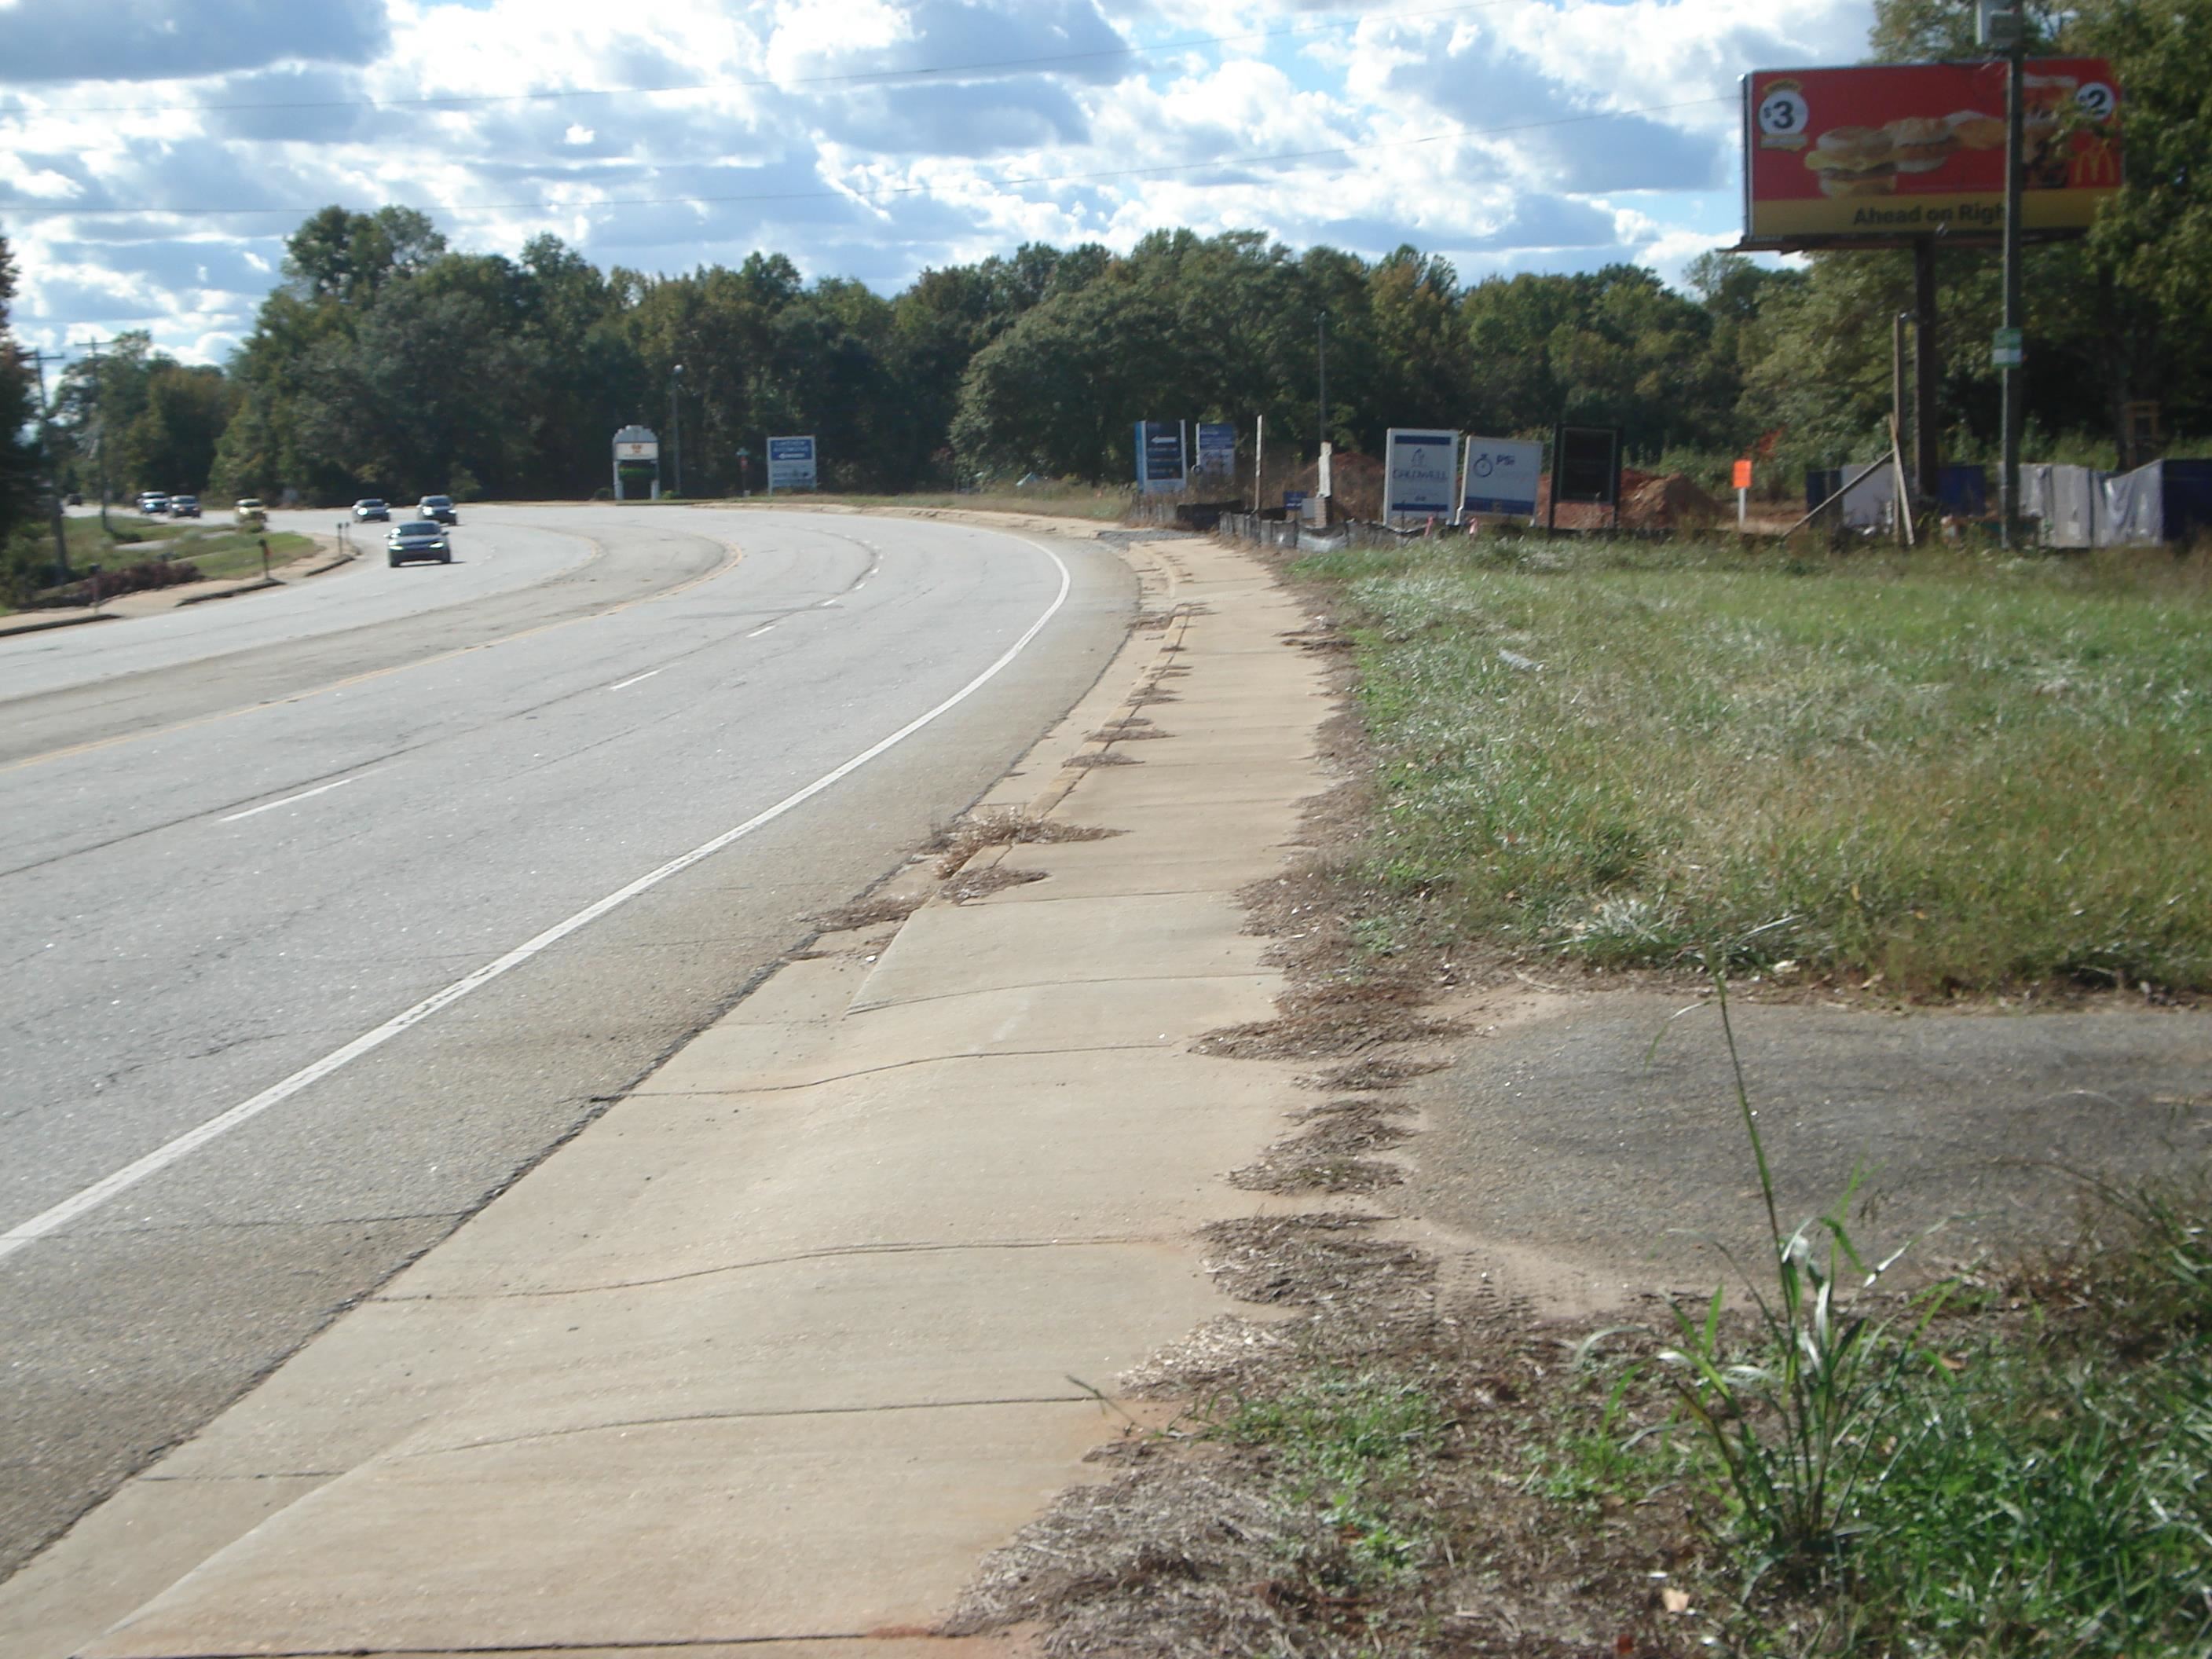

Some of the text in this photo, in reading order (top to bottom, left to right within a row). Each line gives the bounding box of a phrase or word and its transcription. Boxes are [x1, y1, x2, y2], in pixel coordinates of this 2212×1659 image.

[1763, 101, 1795, 129] $3
[1854, 202, 2007, 225] Ahead on Righ
